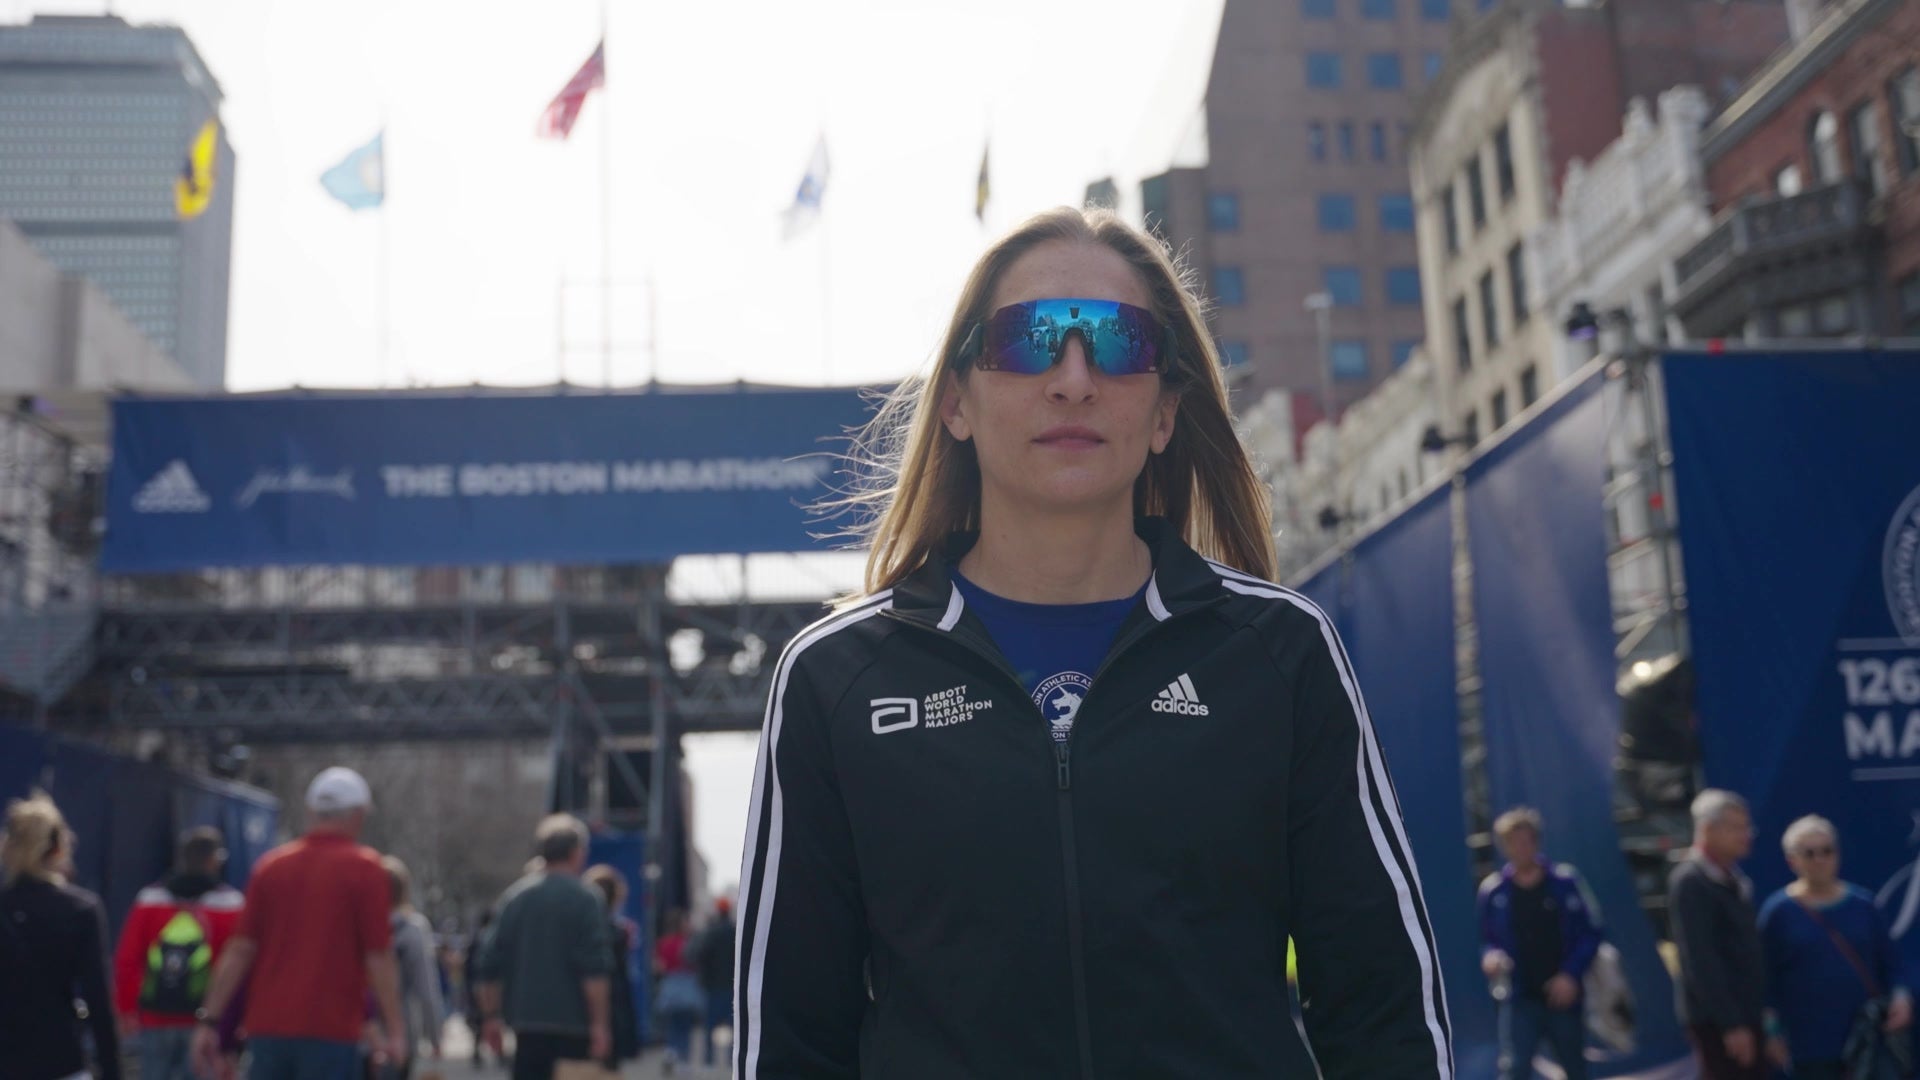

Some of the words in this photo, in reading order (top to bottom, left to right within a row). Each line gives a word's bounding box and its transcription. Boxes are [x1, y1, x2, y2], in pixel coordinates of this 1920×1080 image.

[383, 465, 452, 496] THE
[459, 463, 607, 495] BOSTON
[1041, 674, 1080, 694] ATHLETIC
[1838, 658, 1920, 705] 126
[924, 685, 967, 704] ABBOTT
[924, 695, 965, 711] WORLD
[925, 700, 993, 720] MARATHON
[1151, 697, 1209, 716] adidas
[925, 712, 973, 728] MAJORS
